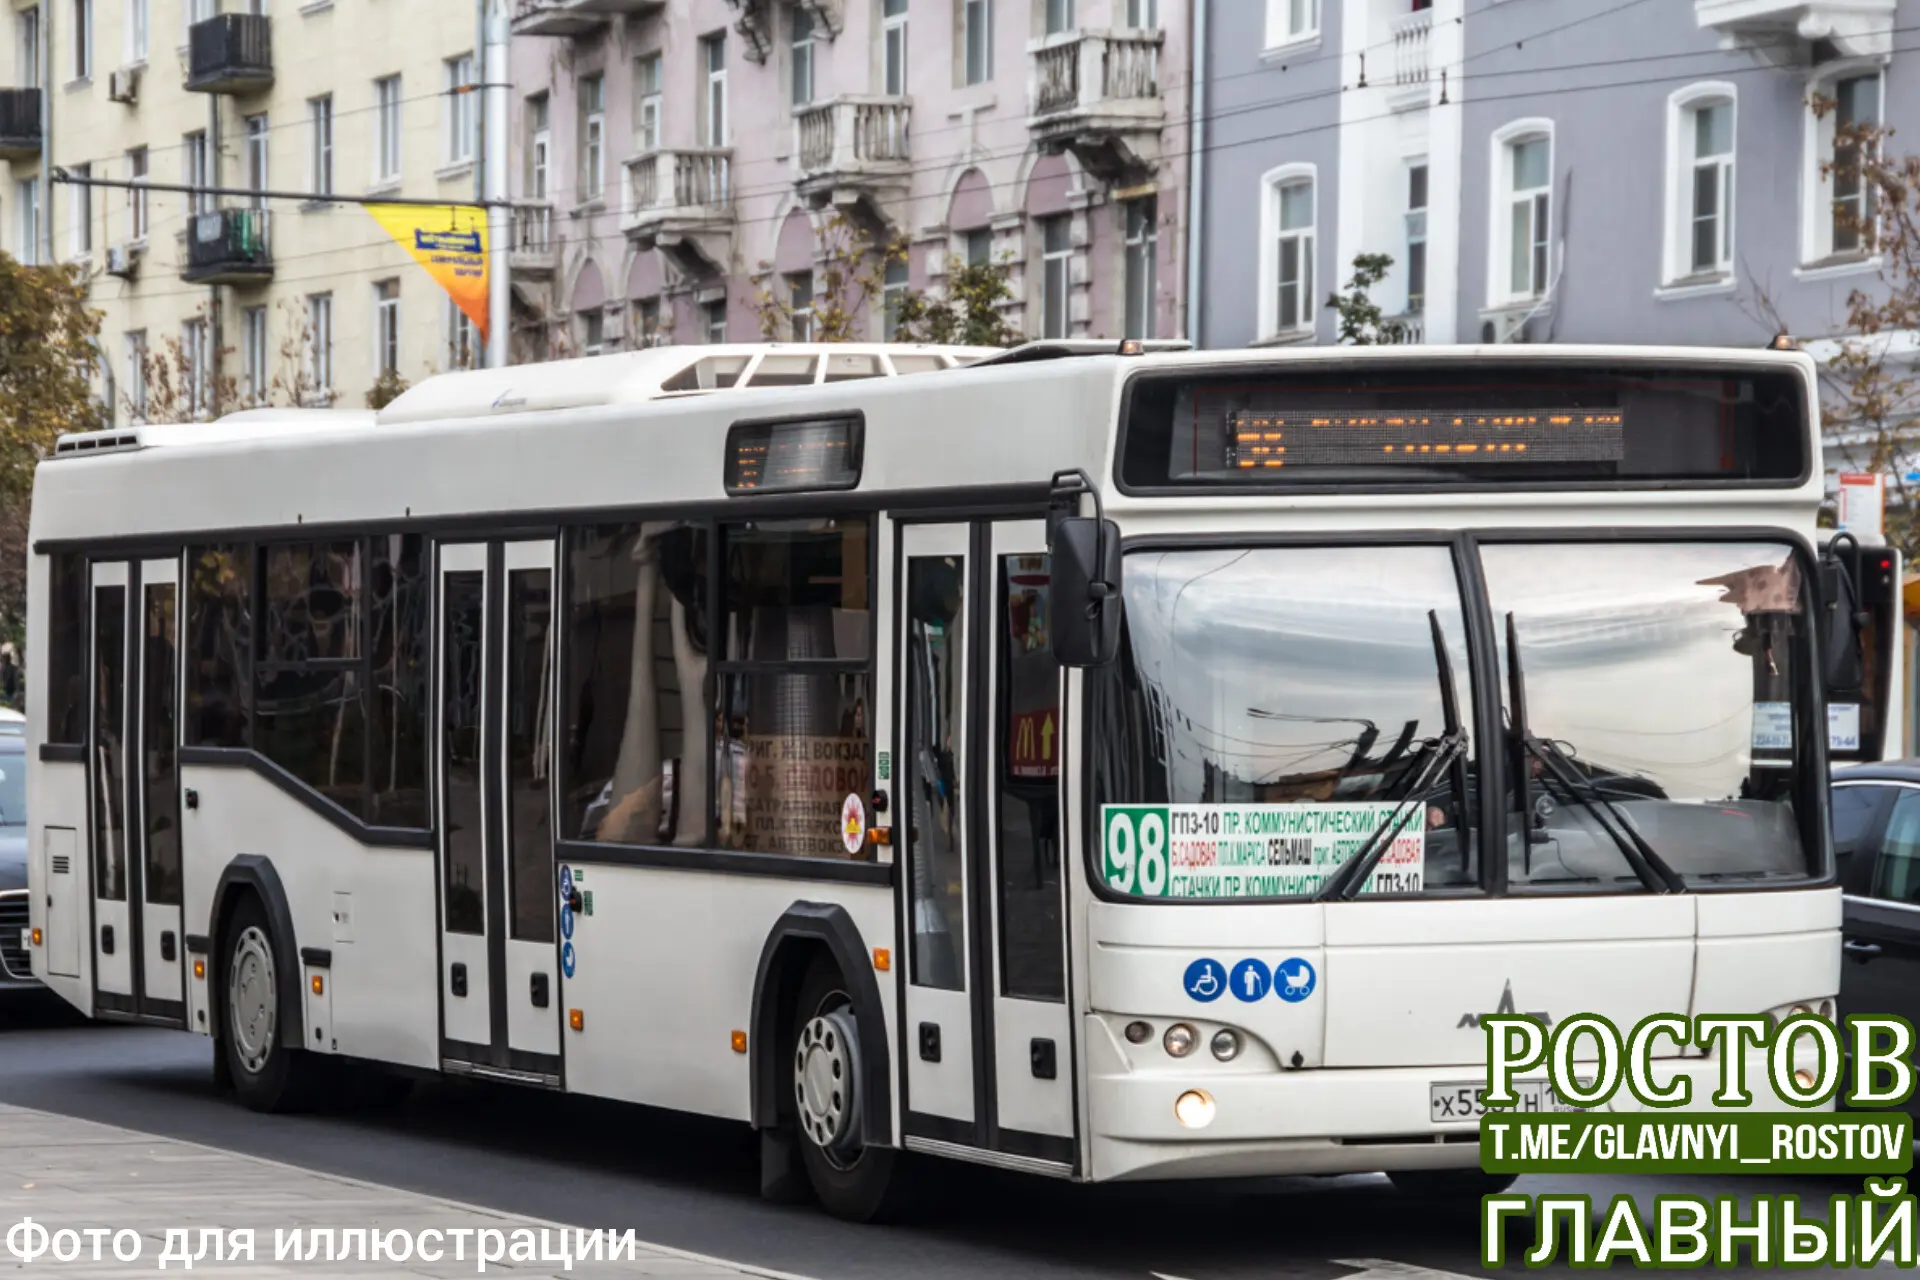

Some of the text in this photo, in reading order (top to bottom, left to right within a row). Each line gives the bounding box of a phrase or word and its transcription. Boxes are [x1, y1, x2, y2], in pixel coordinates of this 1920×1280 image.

[1172, 811, 1219, 834] ГПЗ-10
[1223, 811, 1242, 834] ПР.
[1244, 807, 1375, 833] КОММУНИСТИЧЕСКИЙ
[1108, 811, 1165, 897] 98
[1267, 839, 1312, 866] СЕЛЬМАШ
[1172, 876, 1219, 896] СТАЧКИ
